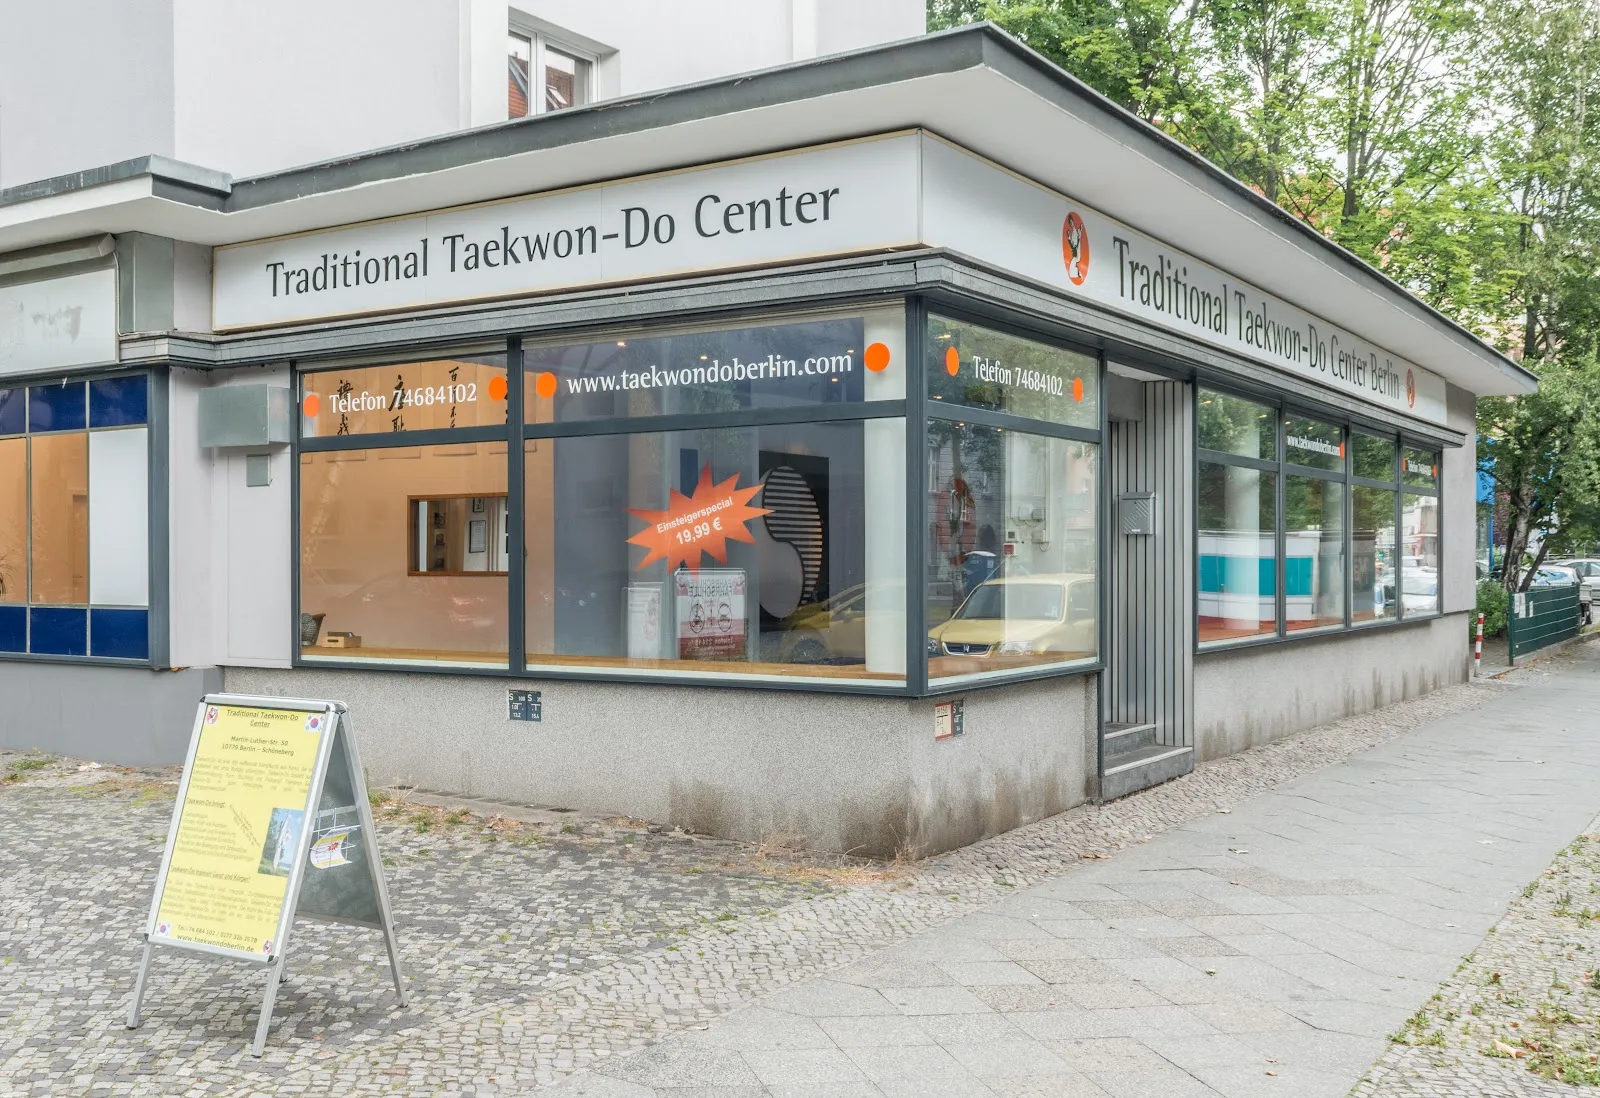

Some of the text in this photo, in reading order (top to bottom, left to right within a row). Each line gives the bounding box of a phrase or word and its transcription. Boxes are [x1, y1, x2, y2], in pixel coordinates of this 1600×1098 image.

[265, 186, 840, 299] Traditional Taekwon-Do Center
[1113, 236, 1400, 400] Traditional Taekwon-Do Center Berlin
[566, 353, 852, 394] www.taekwondoberlin.com
[972, 355, 1063, 396] Telefon 74684102
[329, 383, 477, 414] Telefon 74684102
[656, 496, 733, 534] Einsteigerspecial
[676, 516, 723, 545] 19,99 €
[227, 709, 299, 721] Traditional Taekwon-Do
[250, 719, 270, 728] Center
[239, 744, 256, 752] Berlin
[262, 746, 294, 757] Schöneberg
[176, 934, 254, 952] www.taekwondoberlin.de
